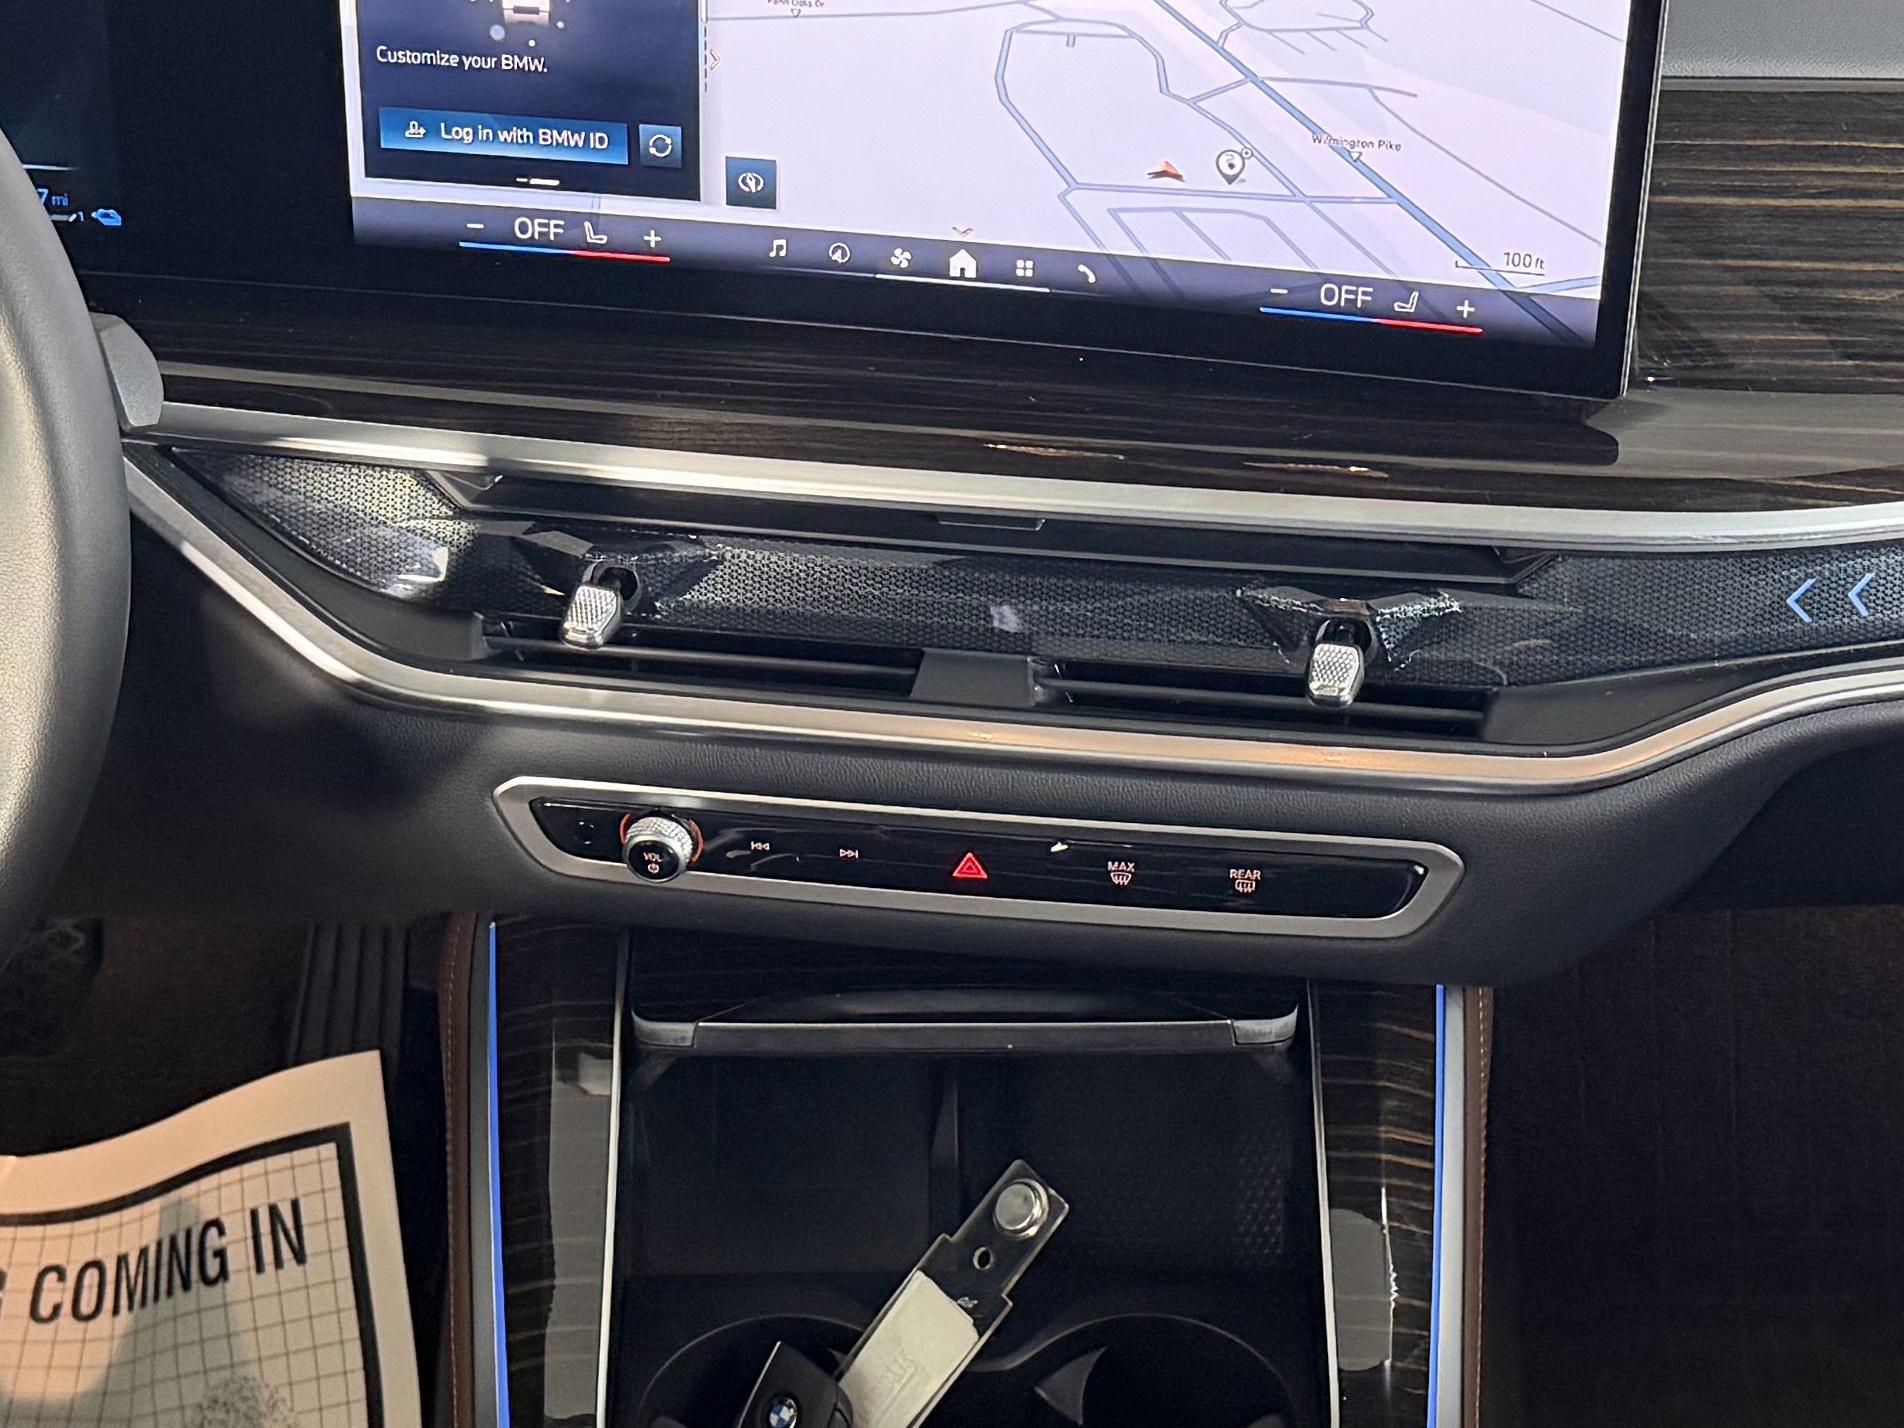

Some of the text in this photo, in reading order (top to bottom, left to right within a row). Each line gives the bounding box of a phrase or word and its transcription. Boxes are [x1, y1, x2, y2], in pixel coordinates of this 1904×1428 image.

[377, 46, 548, 72] Customize your BMW.
[440, 123, 609, 149] Log in with BMW ID
[1312, 134, 1401, 152] Wilmington Pike
[514, 217, 565, 240] OFF
[1504, 252, 1544, 270] 100 ft
[1320, 283, 1374, 309] OFF
[1108, 861, 1134, 872] MAX
[1230, 869, 1261, 880] REAR
[29, 1219, 228, 1324] COMING
[249, 1201, 308, 1274] IN
